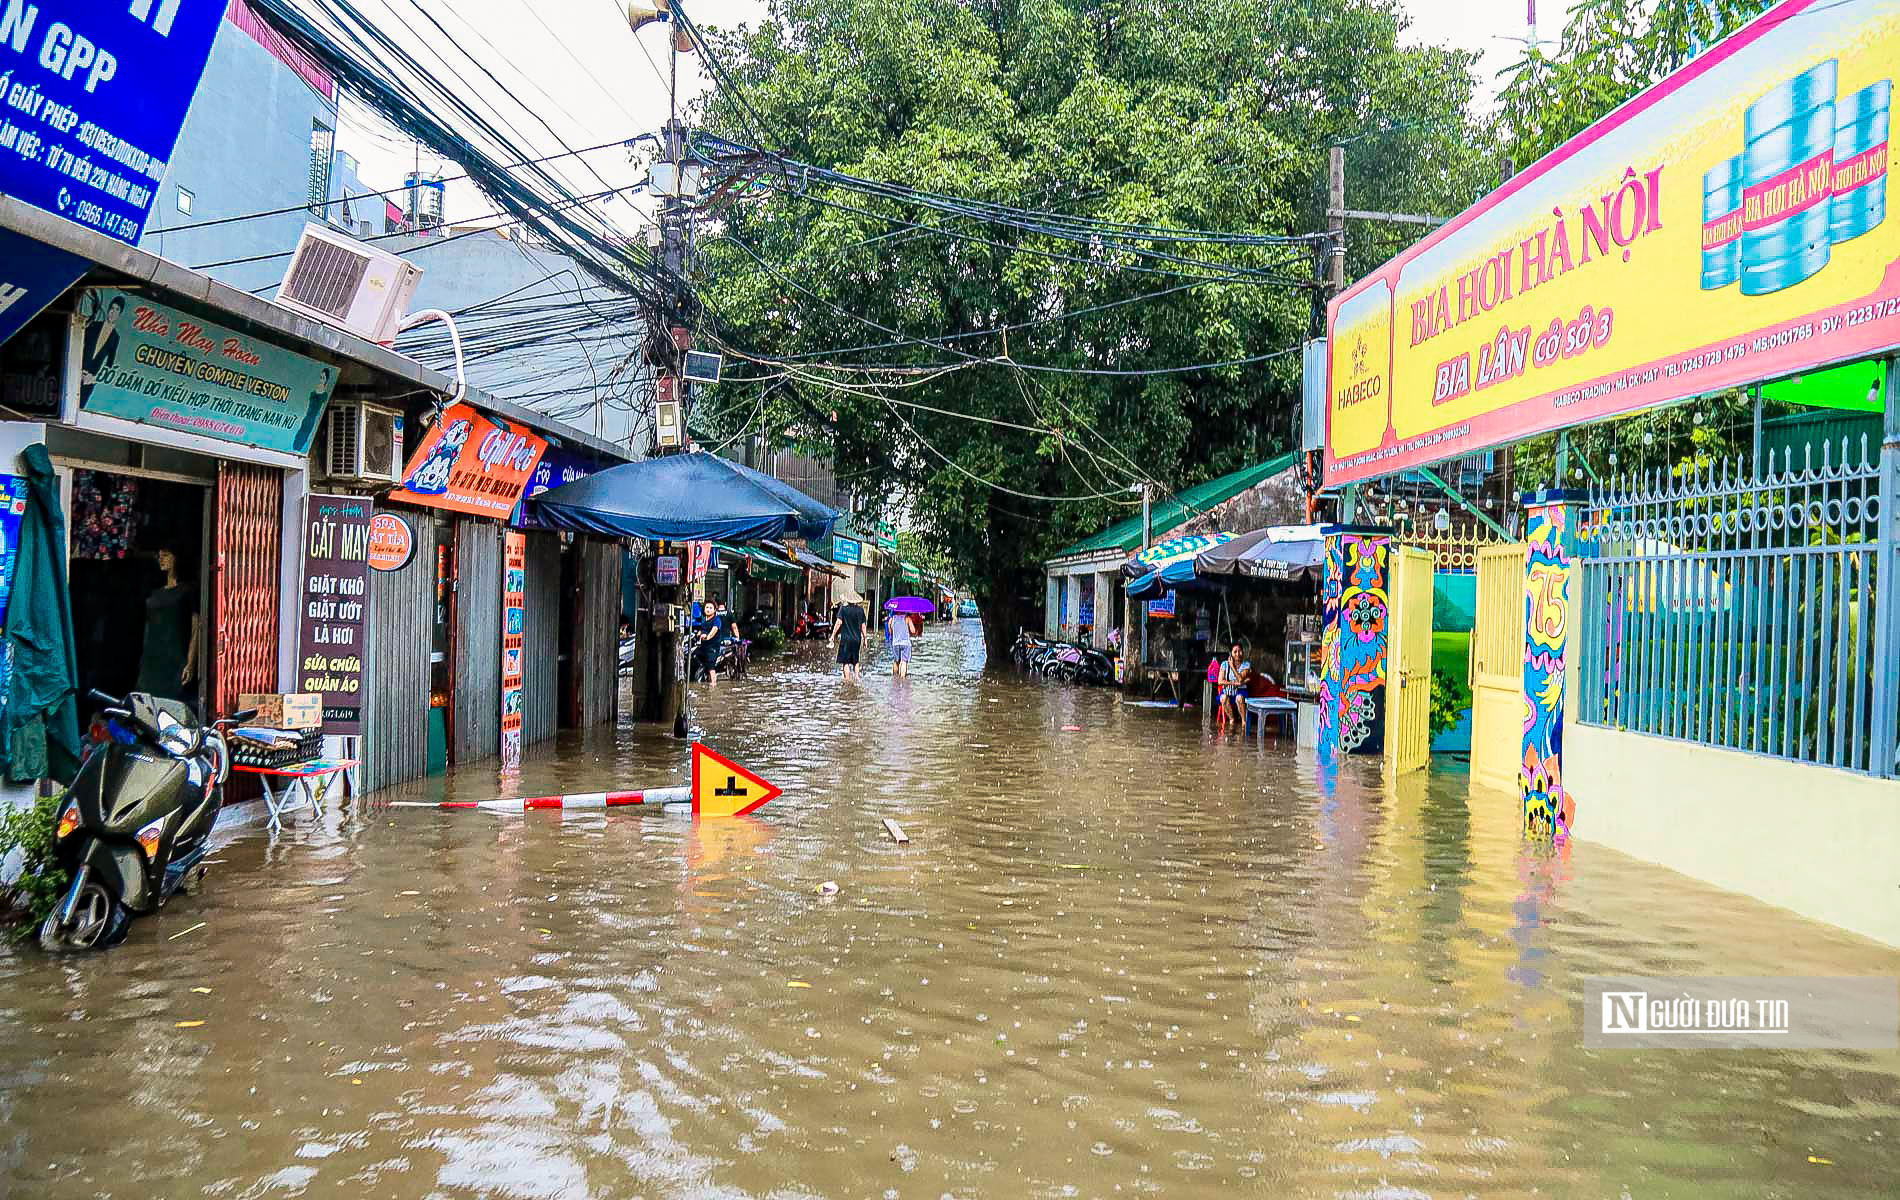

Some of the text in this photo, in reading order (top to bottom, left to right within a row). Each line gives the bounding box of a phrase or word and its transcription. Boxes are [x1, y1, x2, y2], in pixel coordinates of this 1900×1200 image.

[39, 22, 117, 93] GPP
[40, 100, 78, 133] PHÉP
[1745, 195, 1762, 223] BIA
[1788, 168, 1806, 208] HÀ
[1808, 157, 1831, 198] NỘI
[1410, 285, 1453, 347] BIA
[1519, 206, 1574, 295] HÀ
[1579, 164, 1664, 266] NỘI
[176, 321, 216, 356] May
[1435, 357, 1469, 401] BIA
[1478, 331, 1528, 385] LÂN
[1566, 311, 1593, 353] SỞ
[1597, 313, 1610, 342] 3
[135, 344, 289, 403] CHUYÊN COMPLE VESTON
[1338, 374, 1380, 411] HABECO
[1554, 389, 1581, 408] HABECO
[1581, 382, 1612, 401] TRADING
[1642, 367, 1659, 384] HAT
[1664, 362, 1681, 378] TEL:
[1682, 354, 1704, 373] 0243
[1705, 349, 1722, 367] 728
[1724, 342, 1746, 361] 1476
[232, 402, 263, 422] TRANG
[261, 408, 283, 427] NAM
[479, 428, 536, 473] Chill Pet
[310, 515, 371, 561] CẮT MAY
[309, 572, 365, 597] GIẶT KHÔ
[1531, 569, 1566, 638] 75
[308, 598, 363, 622] GIẶT ƯỚT
[331, 626, 354, 645] HƠI
[303, 653, 361, 672] SỬA CHỮA
[304, 671, 359, 693] QUẦN ÁO
